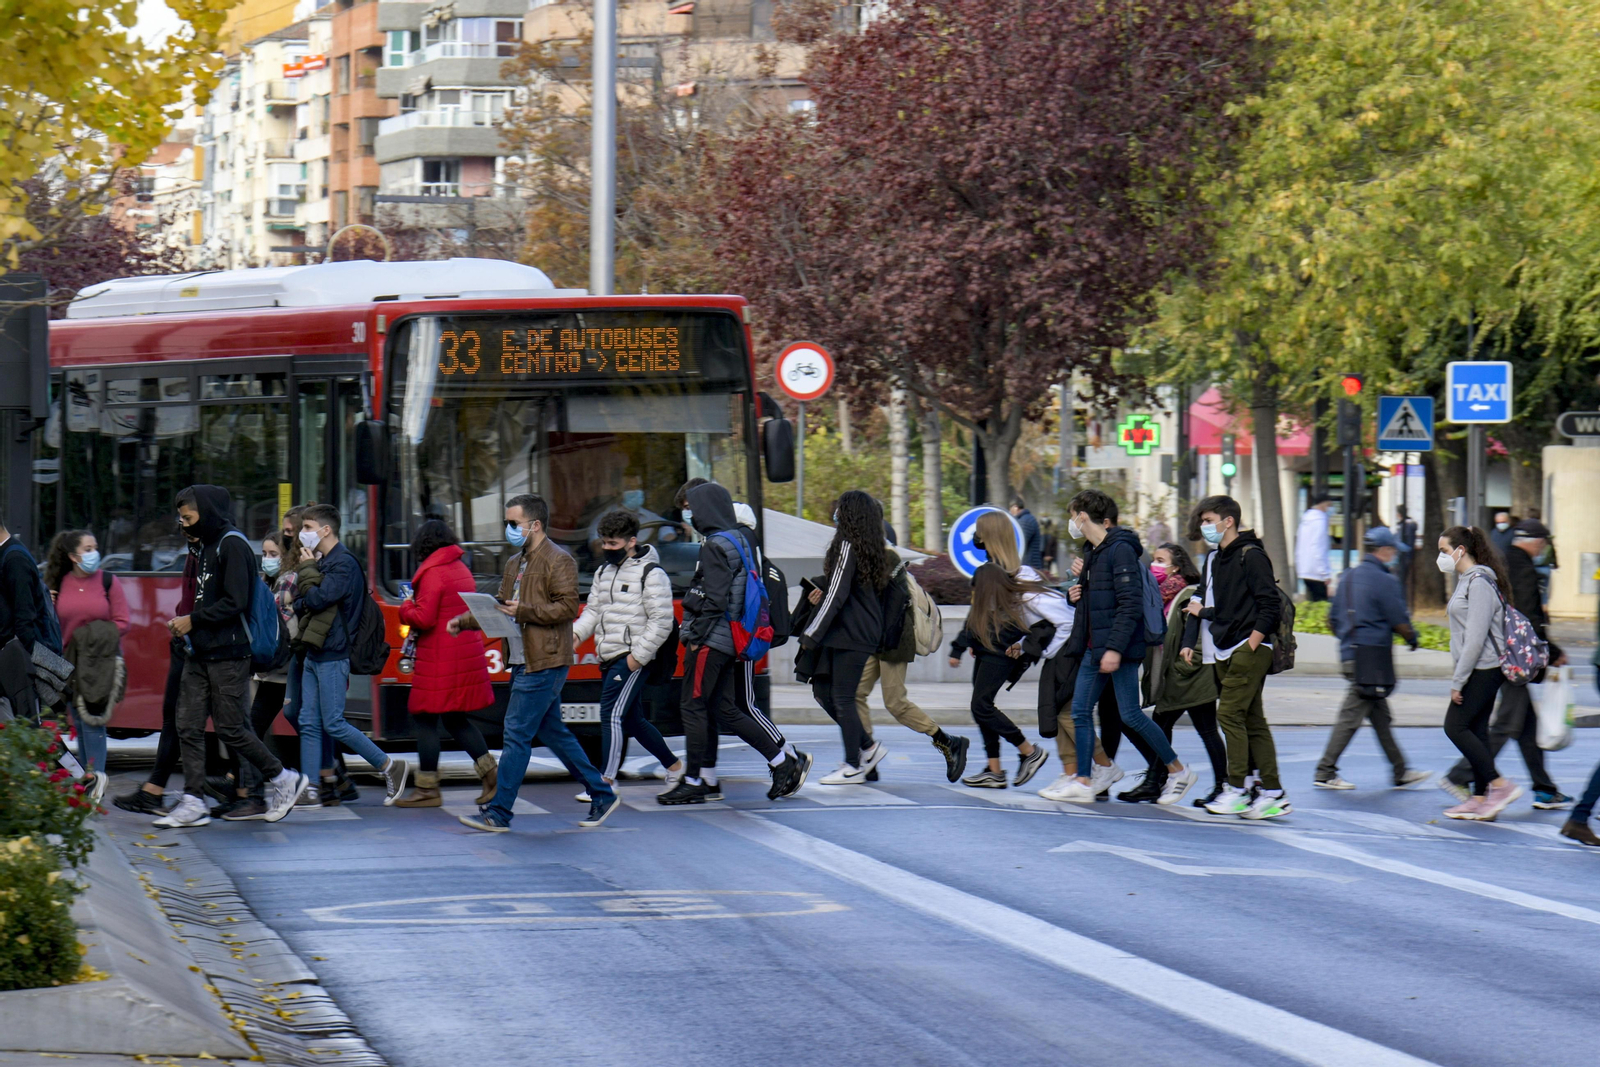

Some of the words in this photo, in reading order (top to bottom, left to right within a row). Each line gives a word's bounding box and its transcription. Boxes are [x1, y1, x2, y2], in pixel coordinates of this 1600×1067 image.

[527, 329, 553, 350] DE
[559, 327, 679, 350] AUTOBUSES
[438, 330, 481, 374] 33
[500, 352, 581, 374] CENTRO
[615, 350, 680, 372] CENES
[1453, 383, 1508, 402] TAXI
